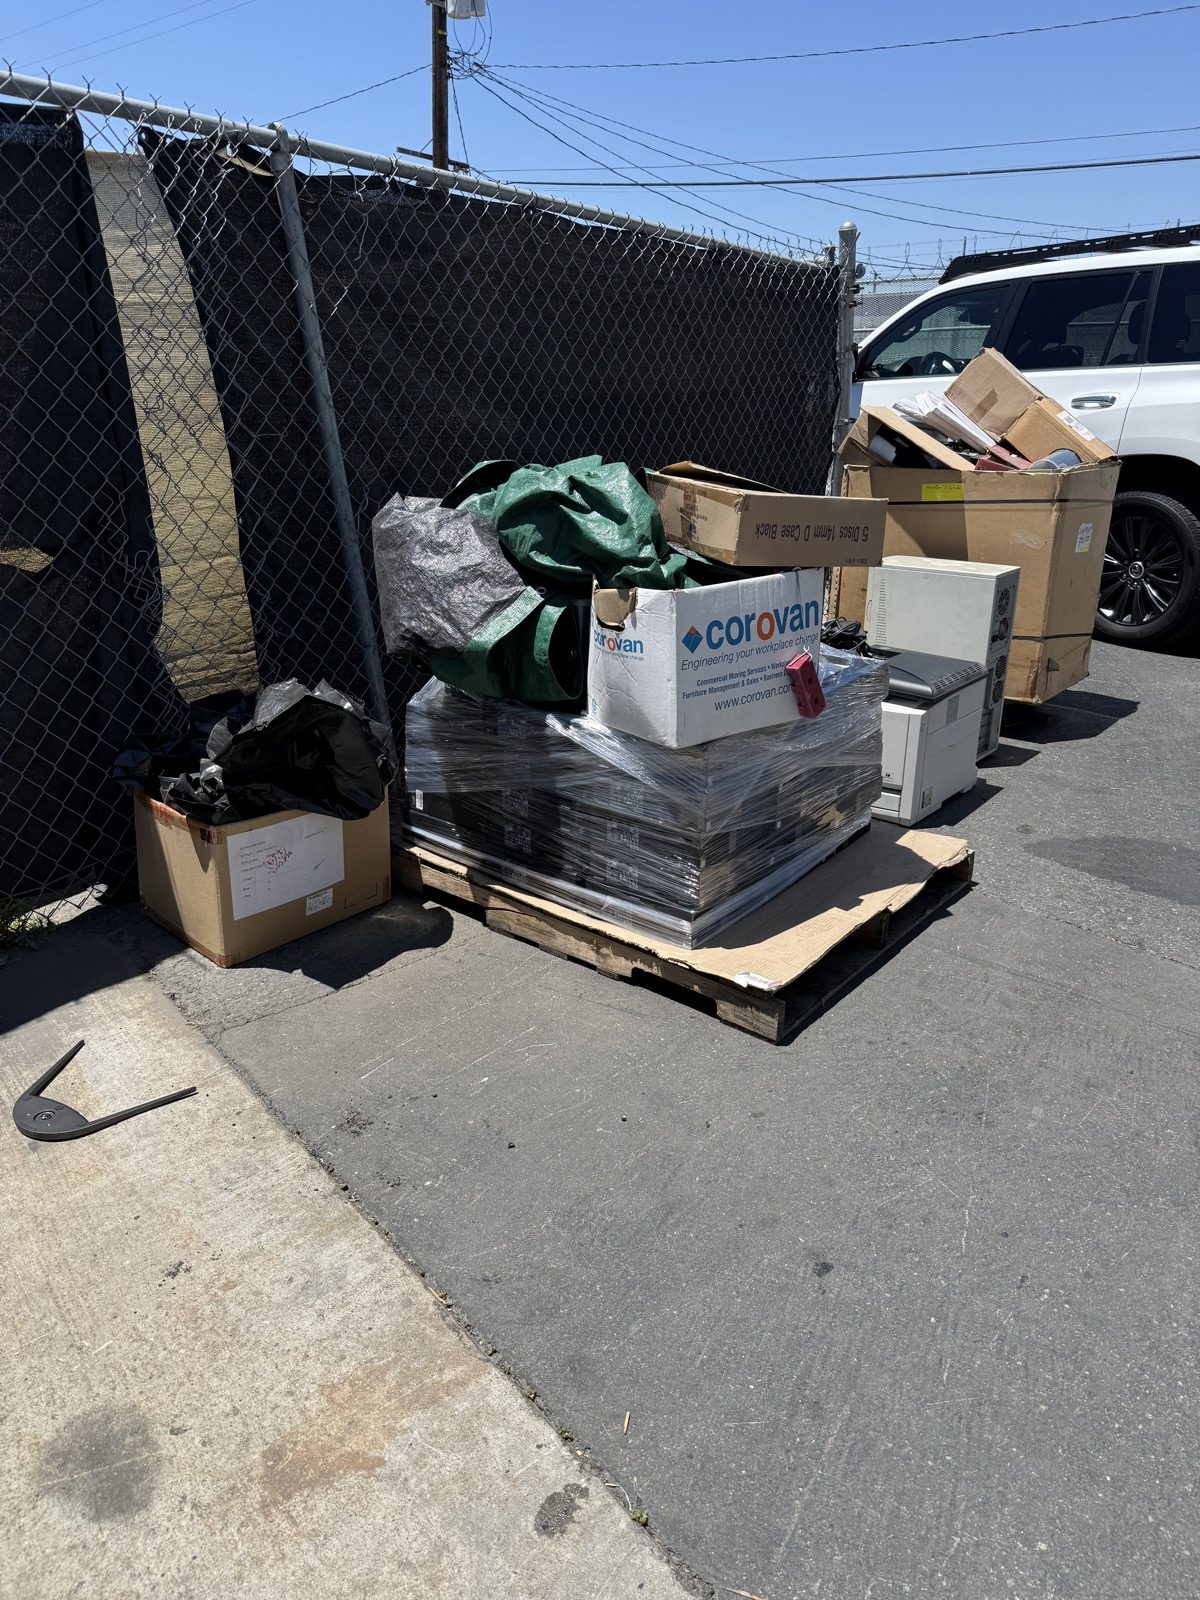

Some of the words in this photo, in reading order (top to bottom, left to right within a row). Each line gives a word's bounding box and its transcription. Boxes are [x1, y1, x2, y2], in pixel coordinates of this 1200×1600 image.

[755, 523, 778, 540] Black
[781, 524, 801, 542] Case
[803, 525, 811, 541] D
[813, 525, 836, 541] 14mm
[839, 525, 859, 543] Discs
[861, 526, 870, 542] 5
[706, 600, 819, 650] corovan
[681, 653, 734, 671] Engineering
[735, 648, 754, 662] your
[755, 638, 794, 655] workplace
[795, 632, 819, 647] change
[682, 688, 707, 700] Furniture
[708, 682, 740, 696] Management
[746, 676, 759, 686] Sales
[763, 670, 783, 682] Business
[696, 674, 728, 687] Commercial
[728, 670, 747, 681] Moving
[747, 666, 767, 676] Services
